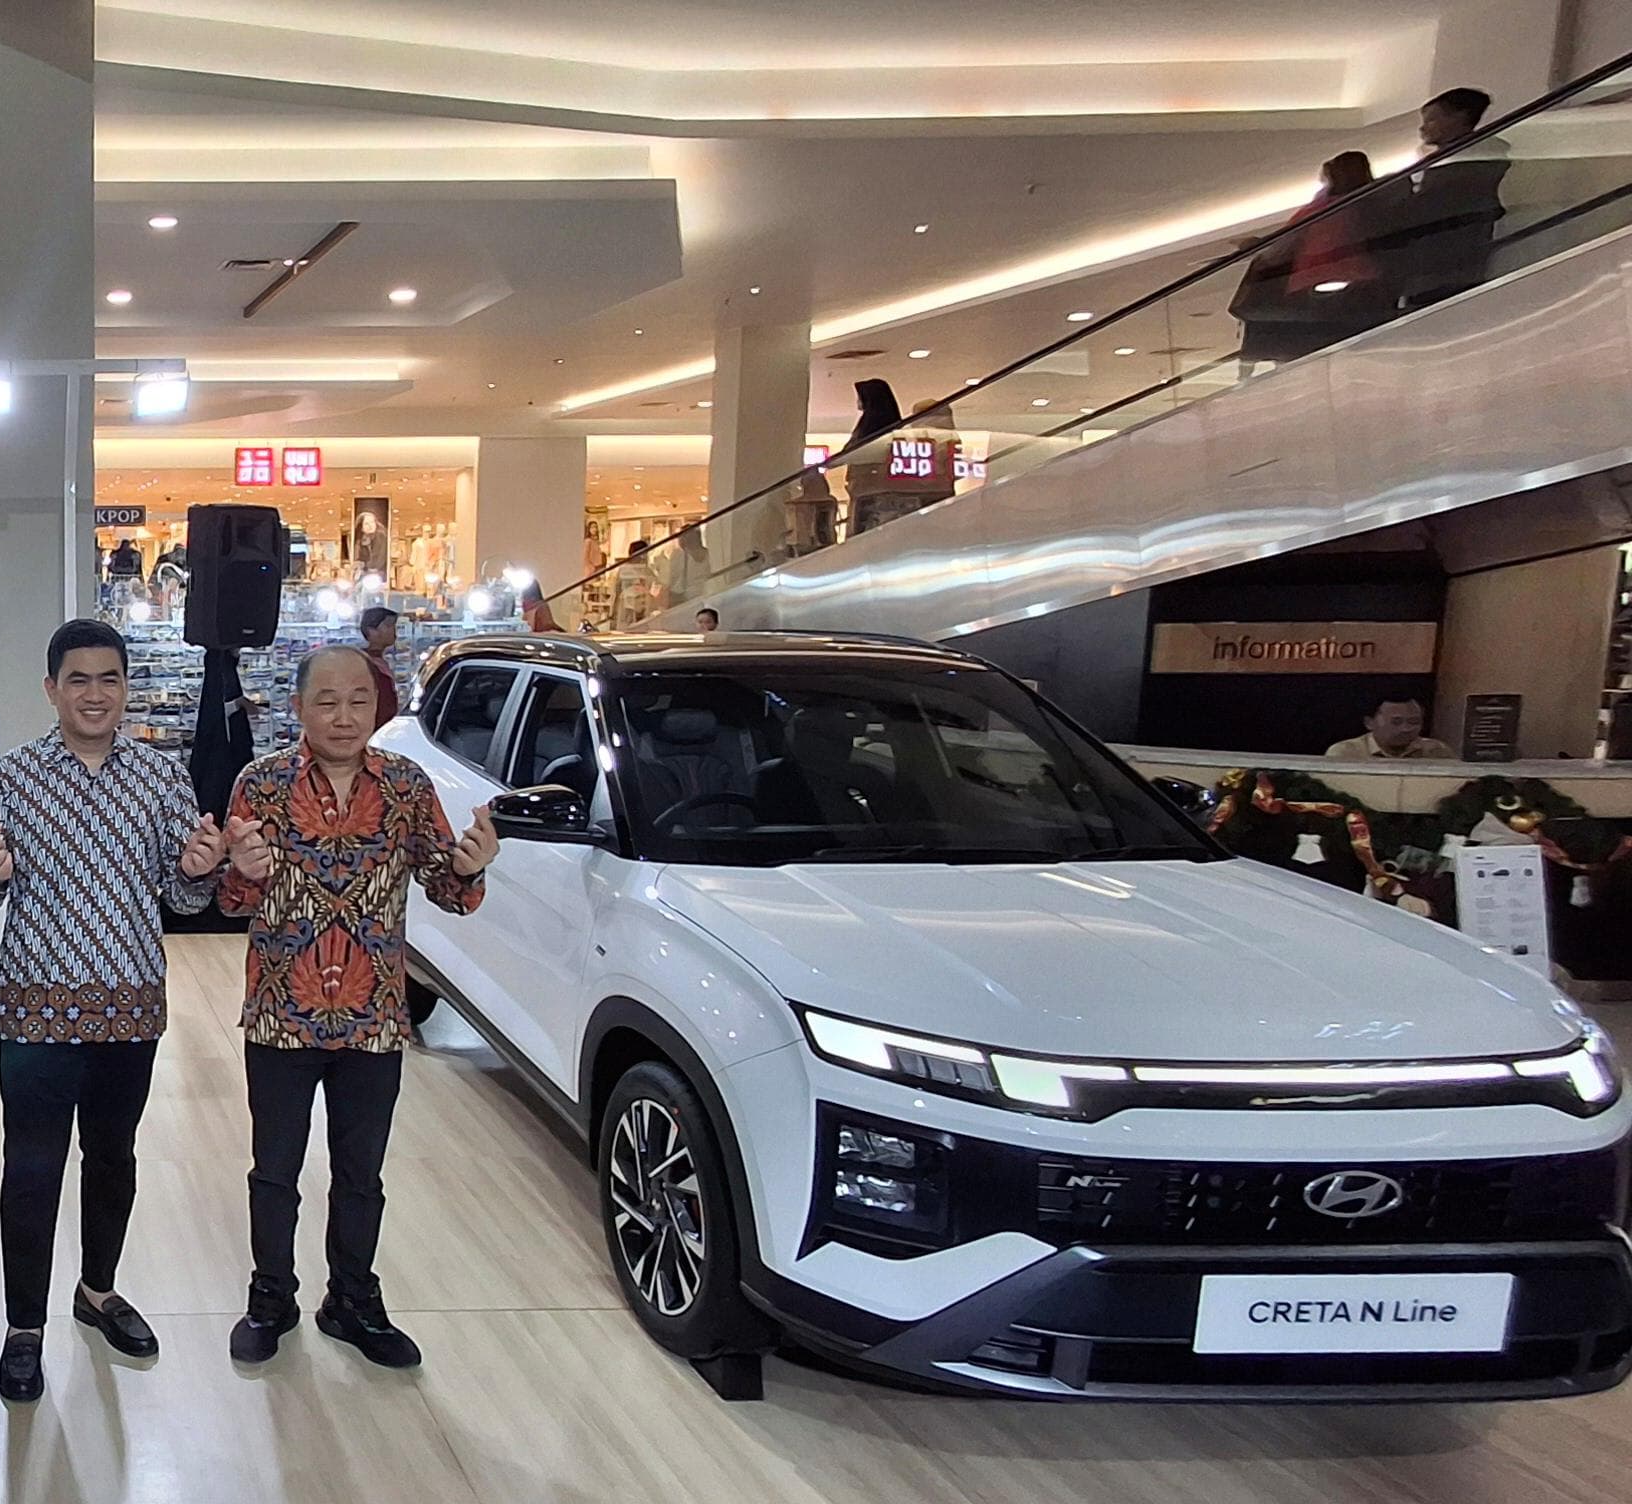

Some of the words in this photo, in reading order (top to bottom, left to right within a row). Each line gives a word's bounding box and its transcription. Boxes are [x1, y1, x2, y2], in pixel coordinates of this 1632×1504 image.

[96, 509, 140, 523] KPOP
[1213, 636, 1376, 660] information
[1248, 1301, 1351, 1323] CRETA
[1360, 1301, 1384, 1322] N
[1392, 1299, 1457, 1323] Line
